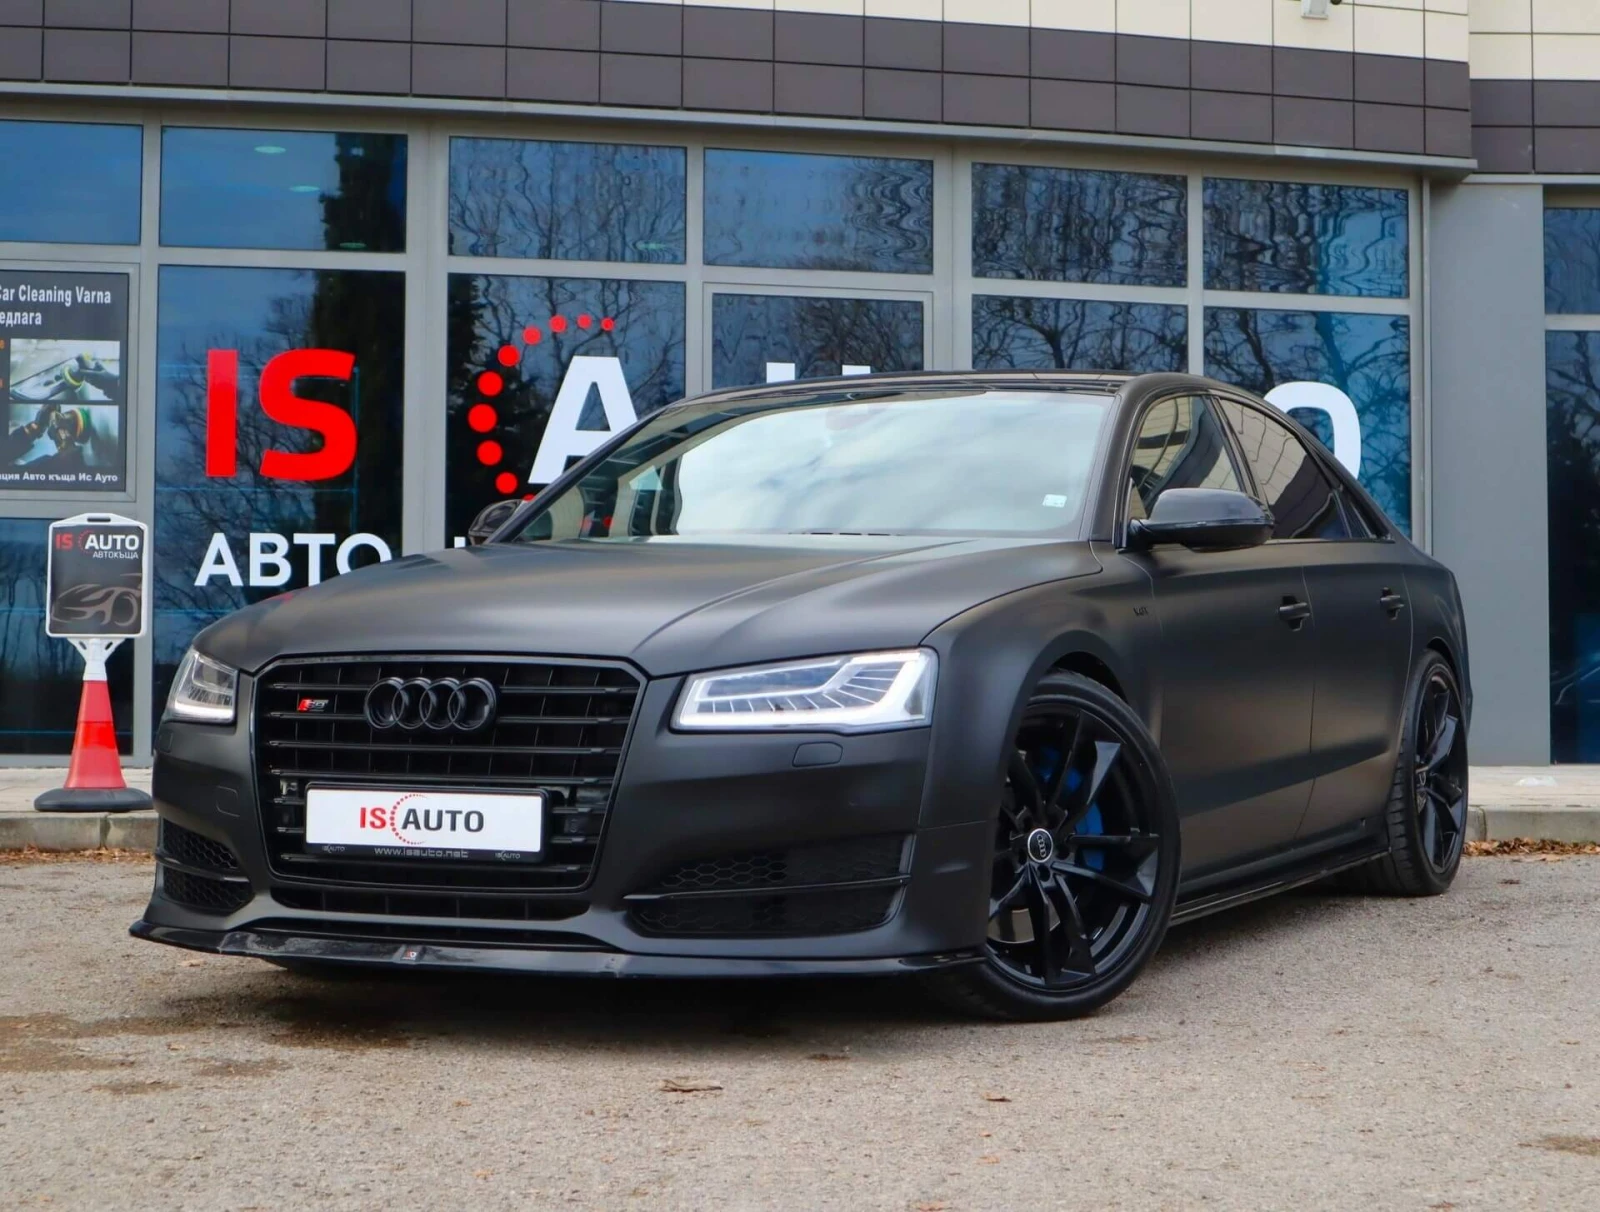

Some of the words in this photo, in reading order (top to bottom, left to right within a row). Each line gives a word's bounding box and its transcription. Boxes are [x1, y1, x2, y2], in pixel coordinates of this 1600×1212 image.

[18, 284, 72, 307] Cleaning
[75, 286, 111, 304] Varna
[205, 348, 358, 481] IS
[22, 472, 46, 481] Авто
[48, 474, 76, 483] къща
[79, 473, 92, 481] Ис
[95, 473, 119, 483] Ауто
[55, 533, 73, 551] IS
[84, 534, 140, 551] AUTO
[360, 807, 387, 829] IS
[401, 808, 484, 833] AUTO
[374, 847, 469, 858] www.isauto.net
